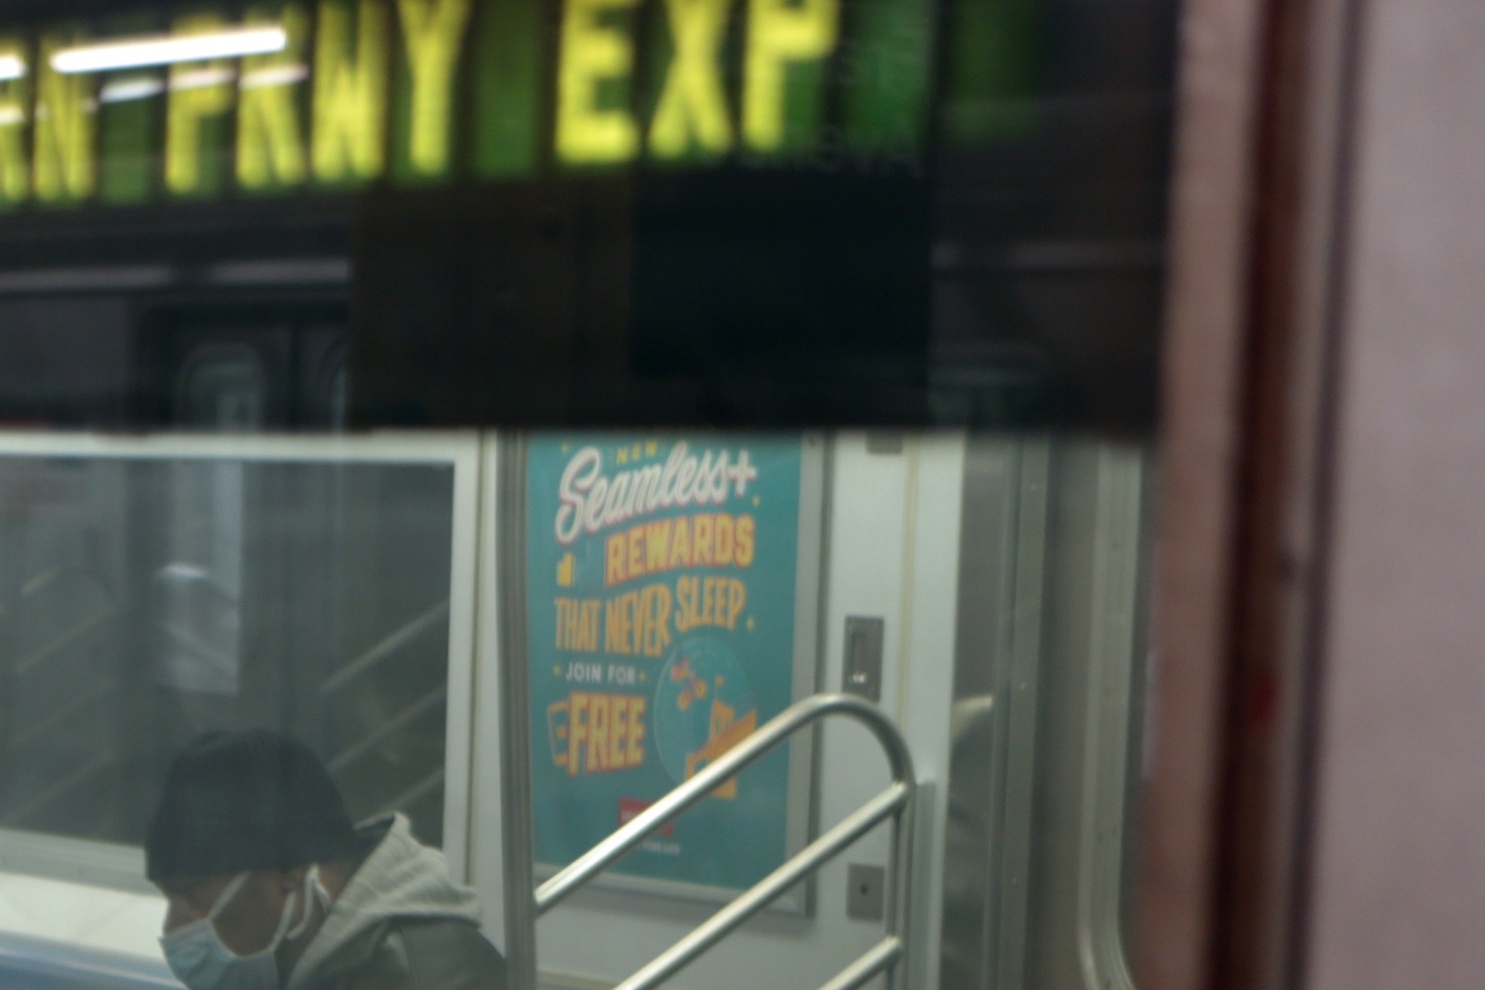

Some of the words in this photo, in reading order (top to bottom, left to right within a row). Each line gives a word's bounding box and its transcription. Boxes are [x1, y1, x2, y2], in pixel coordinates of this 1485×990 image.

[555, 0, 840, 163] EXP
[605, 513, 755, 587] REWARDS
[554, 597, 601, 652] THAT
[605, 583, 672, 657] NEVER
[675, 575, 746, 632] SLEEP
[565, 662, 603, 683] JOIN
[608, 663, 636, 686] FOR
[567, 690, 647, 778] FREE
